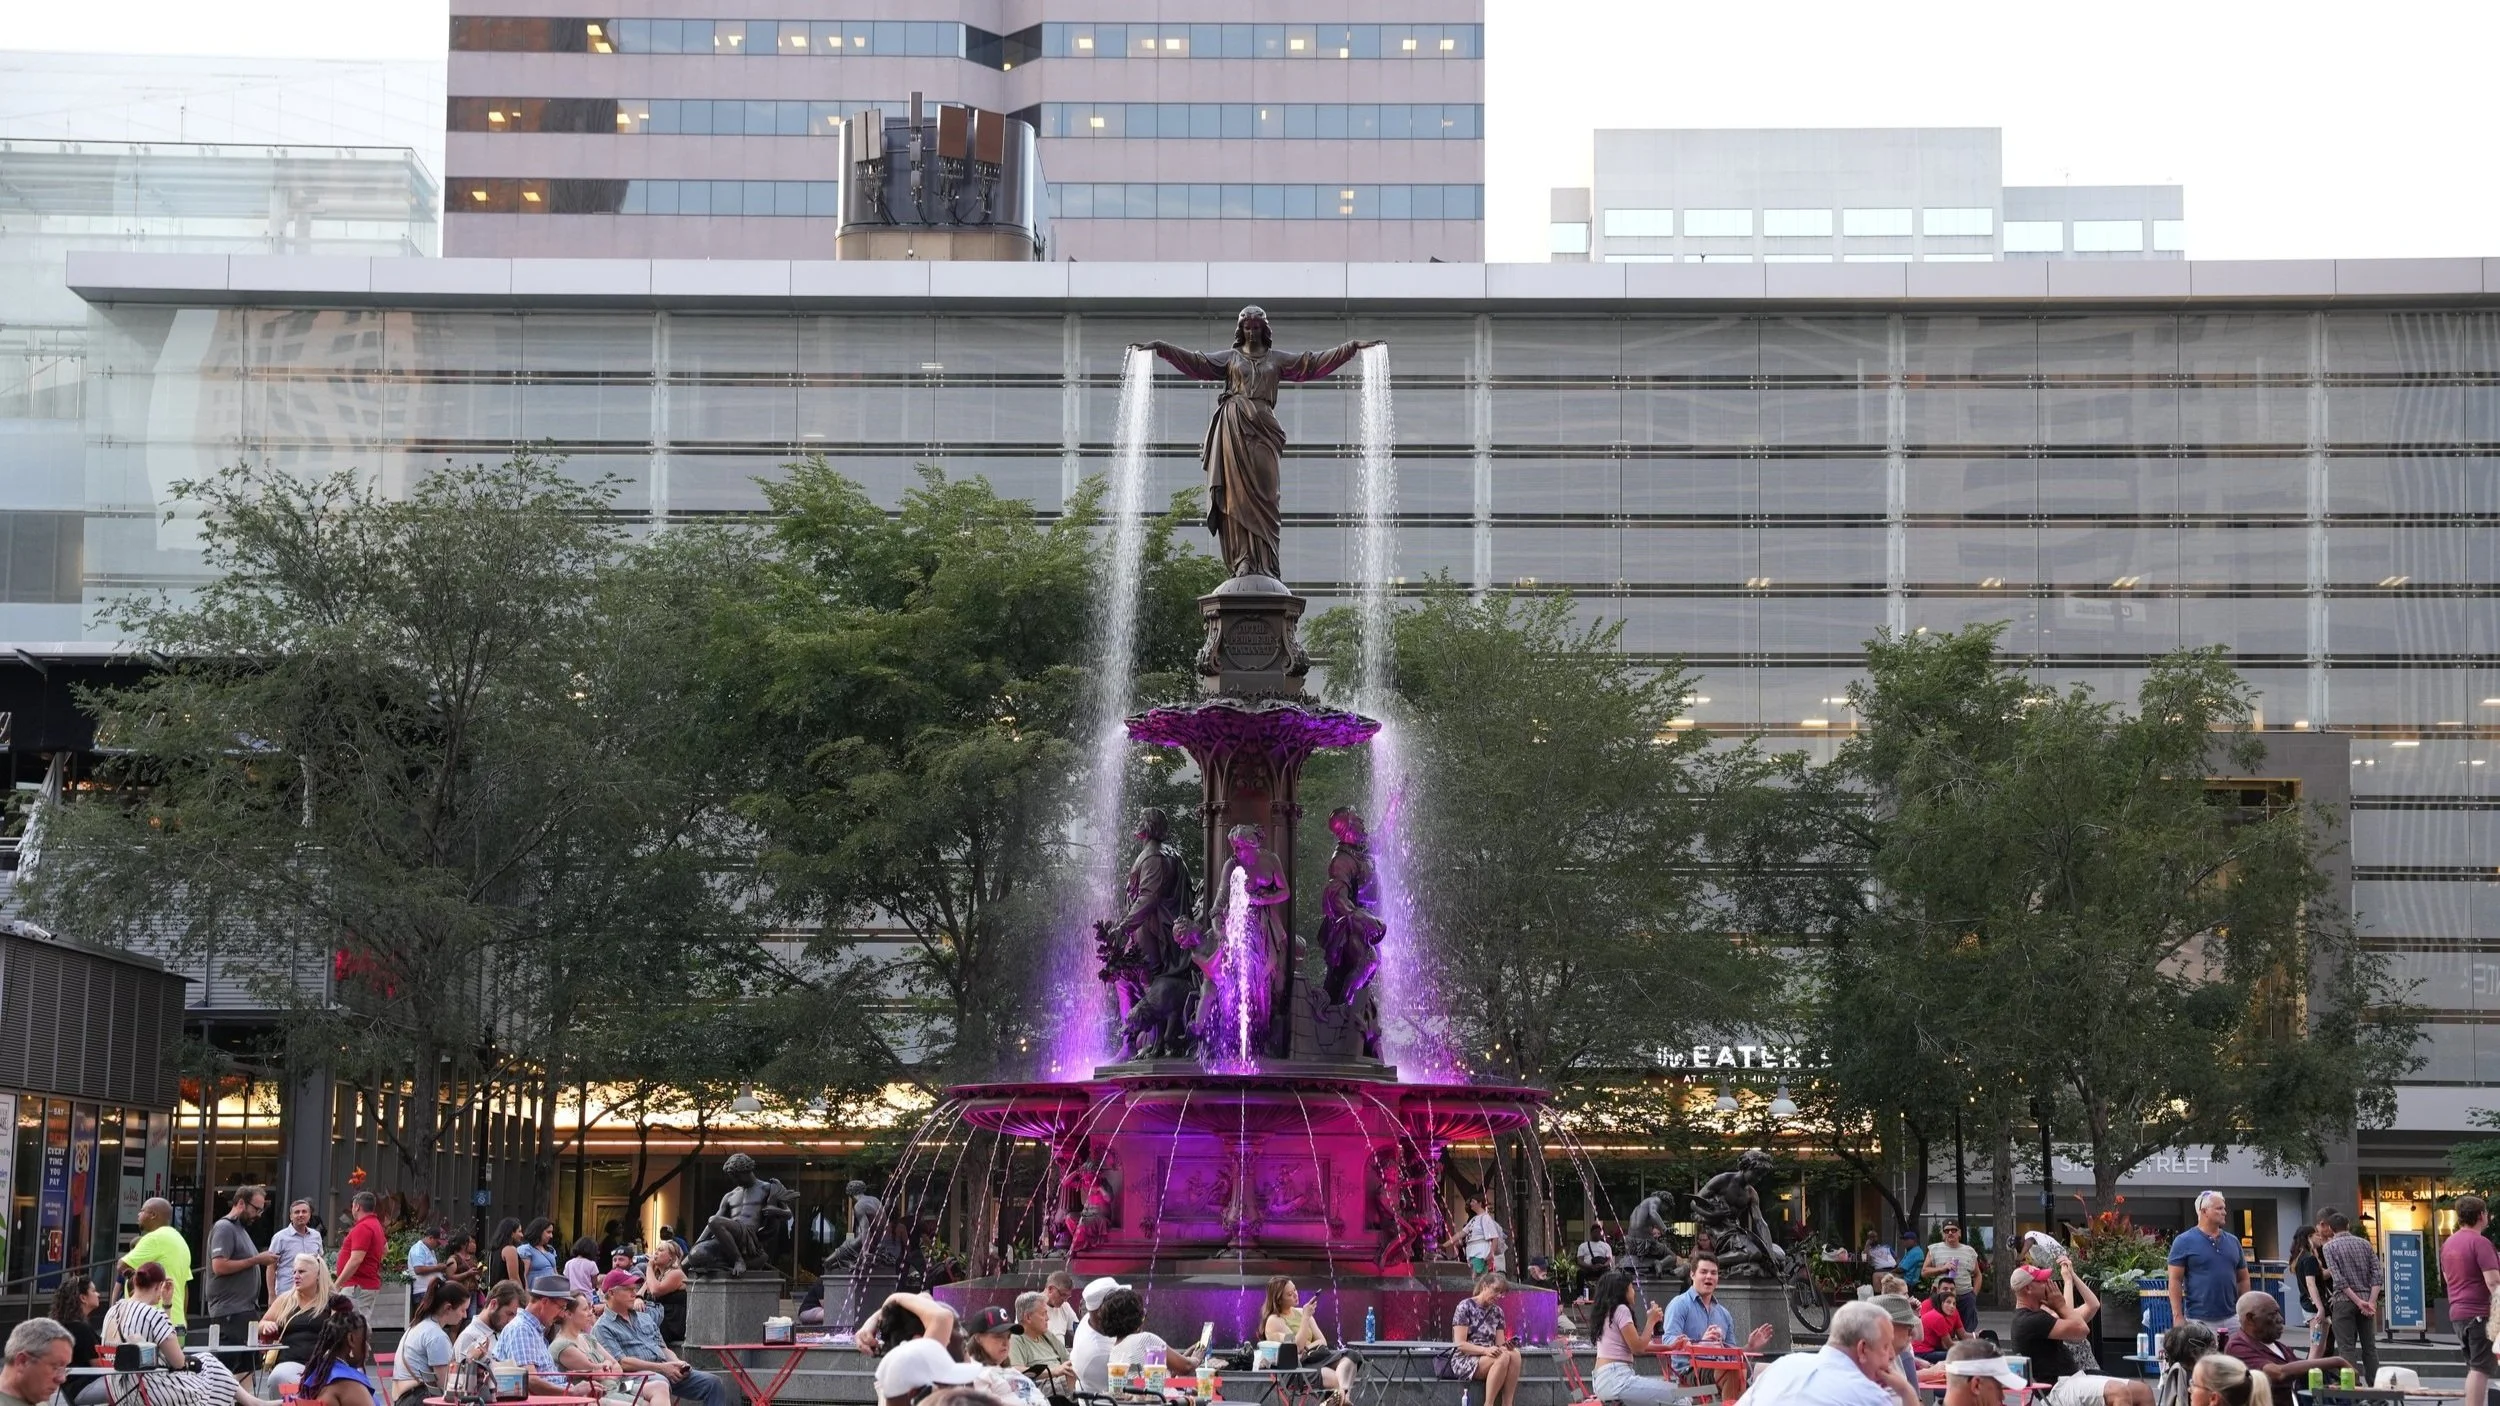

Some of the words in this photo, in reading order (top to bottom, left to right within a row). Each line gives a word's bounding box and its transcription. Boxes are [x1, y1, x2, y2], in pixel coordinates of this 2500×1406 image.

[1683, 1074, 1697, 1083] AT
[47, 1147, 65, 1156] EVERY
[48, 1157, 63, 1166] TIME
[49, 1168, 61, 1176] YOU
[48, 1178, 60, 1186] PAY
[2392, 1249, 2404, 1257] PARK
[2404, 1249, 2418, 1257] RULES
